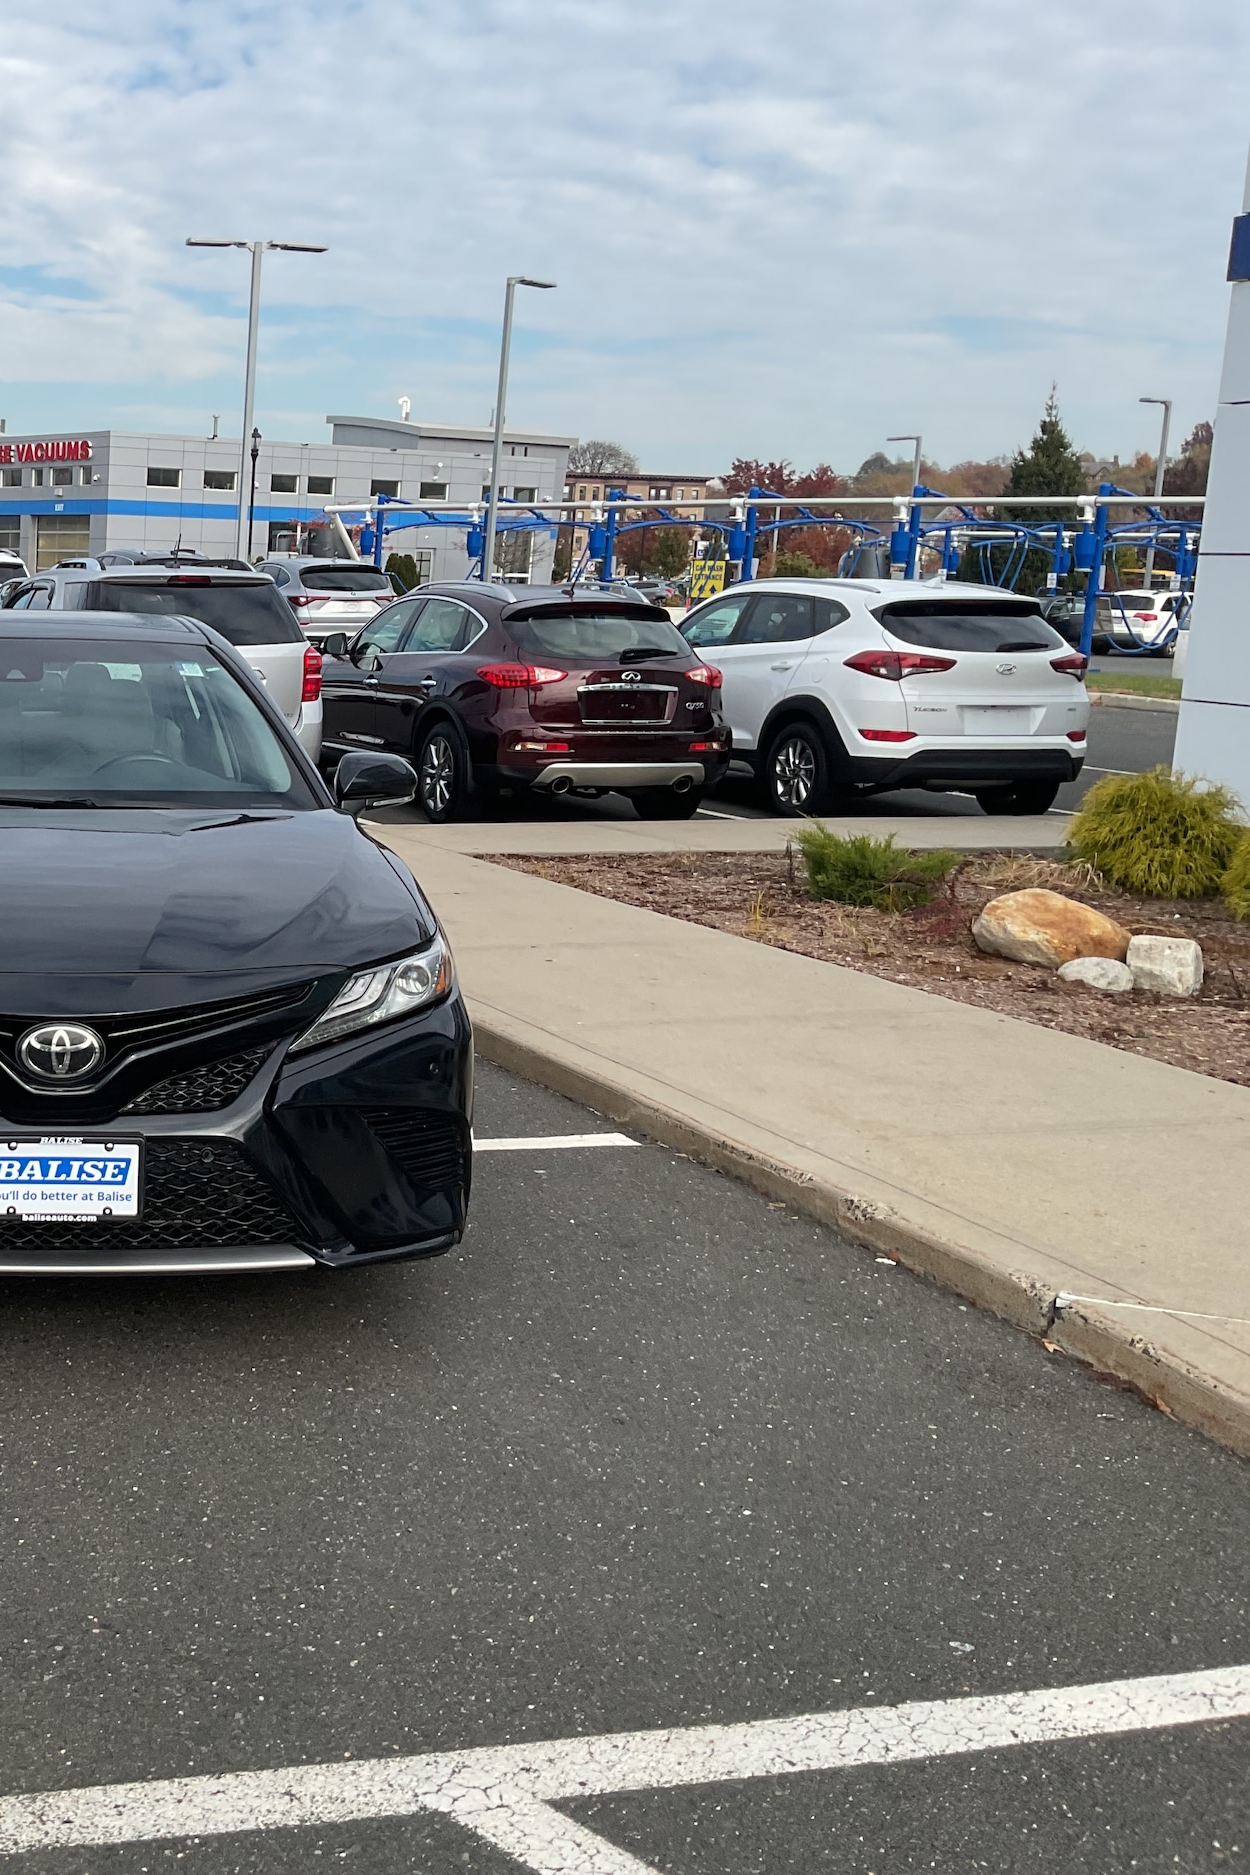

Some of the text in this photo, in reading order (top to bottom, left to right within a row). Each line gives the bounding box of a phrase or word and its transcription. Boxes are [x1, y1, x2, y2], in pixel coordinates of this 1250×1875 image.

[16, 440, 93, 463] VACUUMS
[39, 1136, 84, 1145] BALISE
[22, 1190, 38, 1201] do
[41, 1190, 78, 1201] better
[81, 1192, 94, 1201] at
[97, 1191, 132, 1202] Balise
[21, 1213, 98, 1222] baliseauto.com
